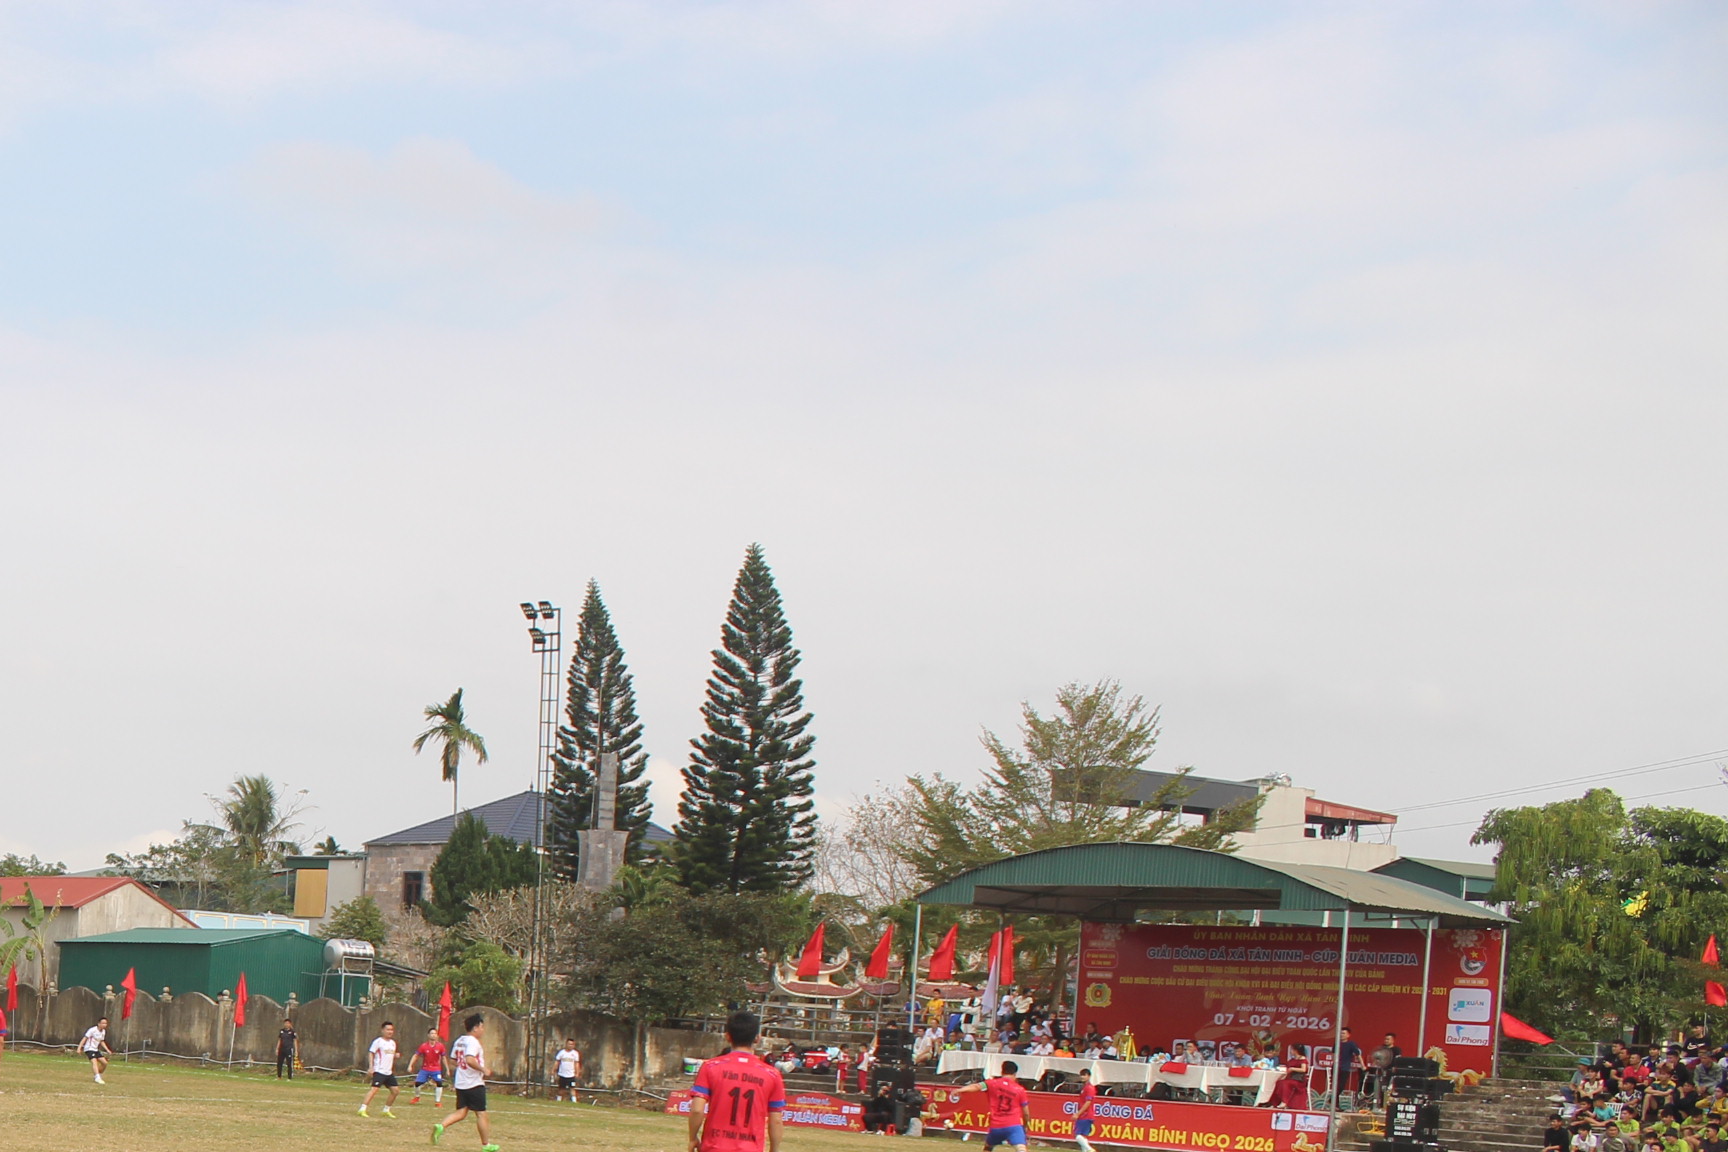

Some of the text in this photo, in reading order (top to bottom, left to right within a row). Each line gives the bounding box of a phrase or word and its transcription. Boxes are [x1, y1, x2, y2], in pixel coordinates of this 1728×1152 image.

[1210, 932, 1232, 940] BAN
[1348, 934, 1369, 942] INH
[1146, 944, 1171, 959] GIẢI
[1173, 945, 1207, 959] BÓNG
[1208, 946, 1226, 960] ĐÁ
[1227, 946, 1246, 960] XÃ
[1248, 947, 1271, 961] TÂN
[1272, 949, 1303, 962] NINH
[1312, 948, 1338, 962] CÚP
[1377, 952, 1418, 966] MEDIA
[1432, 987, 1447, 995] 2031
[1214, 1013, 1234, 1026] 07
[1249, 1014, 1271, 1027] 02
[1286, 1016, 1330, 1030] 2026
[1461, 1036, 1488, 1045] Phong
[728, 1086, 754, 1128] 11
[998, 1094, 1013, 1112] 13
[1063, 1102, 1154, 1120] GI BÓNG ĐÁ
[818, 1113, 848, 1126] MEDIA
[712, 1129, 720, 1137] FC
[953, 1110, 973, 1126] XÃ
[1100, 1123, 1145, 1140] XUÂN
[1149, 1128, 1186, 1144] BÍNH
[1192, 1133, 1230, 1152] NGỌ
[1234, 1136, 1274, 1152] 2026
